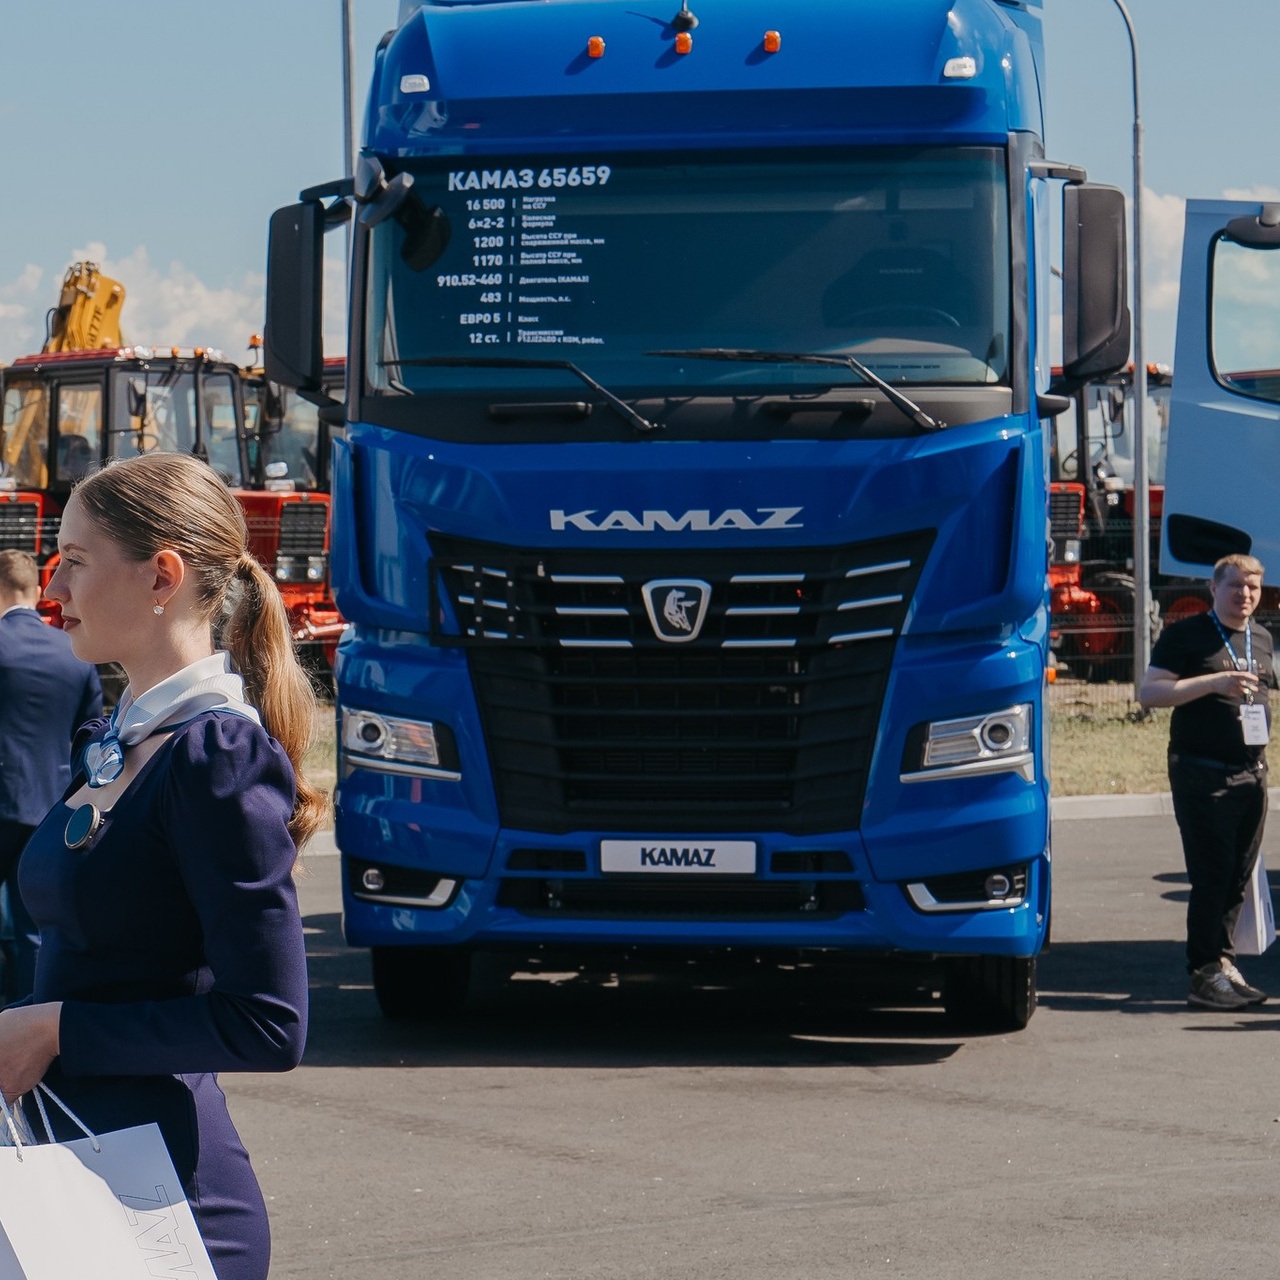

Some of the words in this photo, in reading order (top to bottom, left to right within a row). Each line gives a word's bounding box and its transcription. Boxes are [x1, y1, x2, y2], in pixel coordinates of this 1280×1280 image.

[448, 169, 534, 191] КАМАЗ
[538, 166, 611, 188] 65659
[466, 199, 481, 211] 16
[483, 198, 505, 210] 500
[474, 236, 503, 249] 1200
[473, 255, 503, 267] 1170
[437, 273, 502, 287] 910.52-460
[480, 292, 501, 303] 483
[460, 313, 491, 324] ЕВРО
[493, 313, 501, 323] 5
[470, 333, 482, 343] 12
[484, 334, 500, 343] ст.
[550, 507, 804, 531] KAMAZ
[640, 847, 716, 867] KAMAZ
